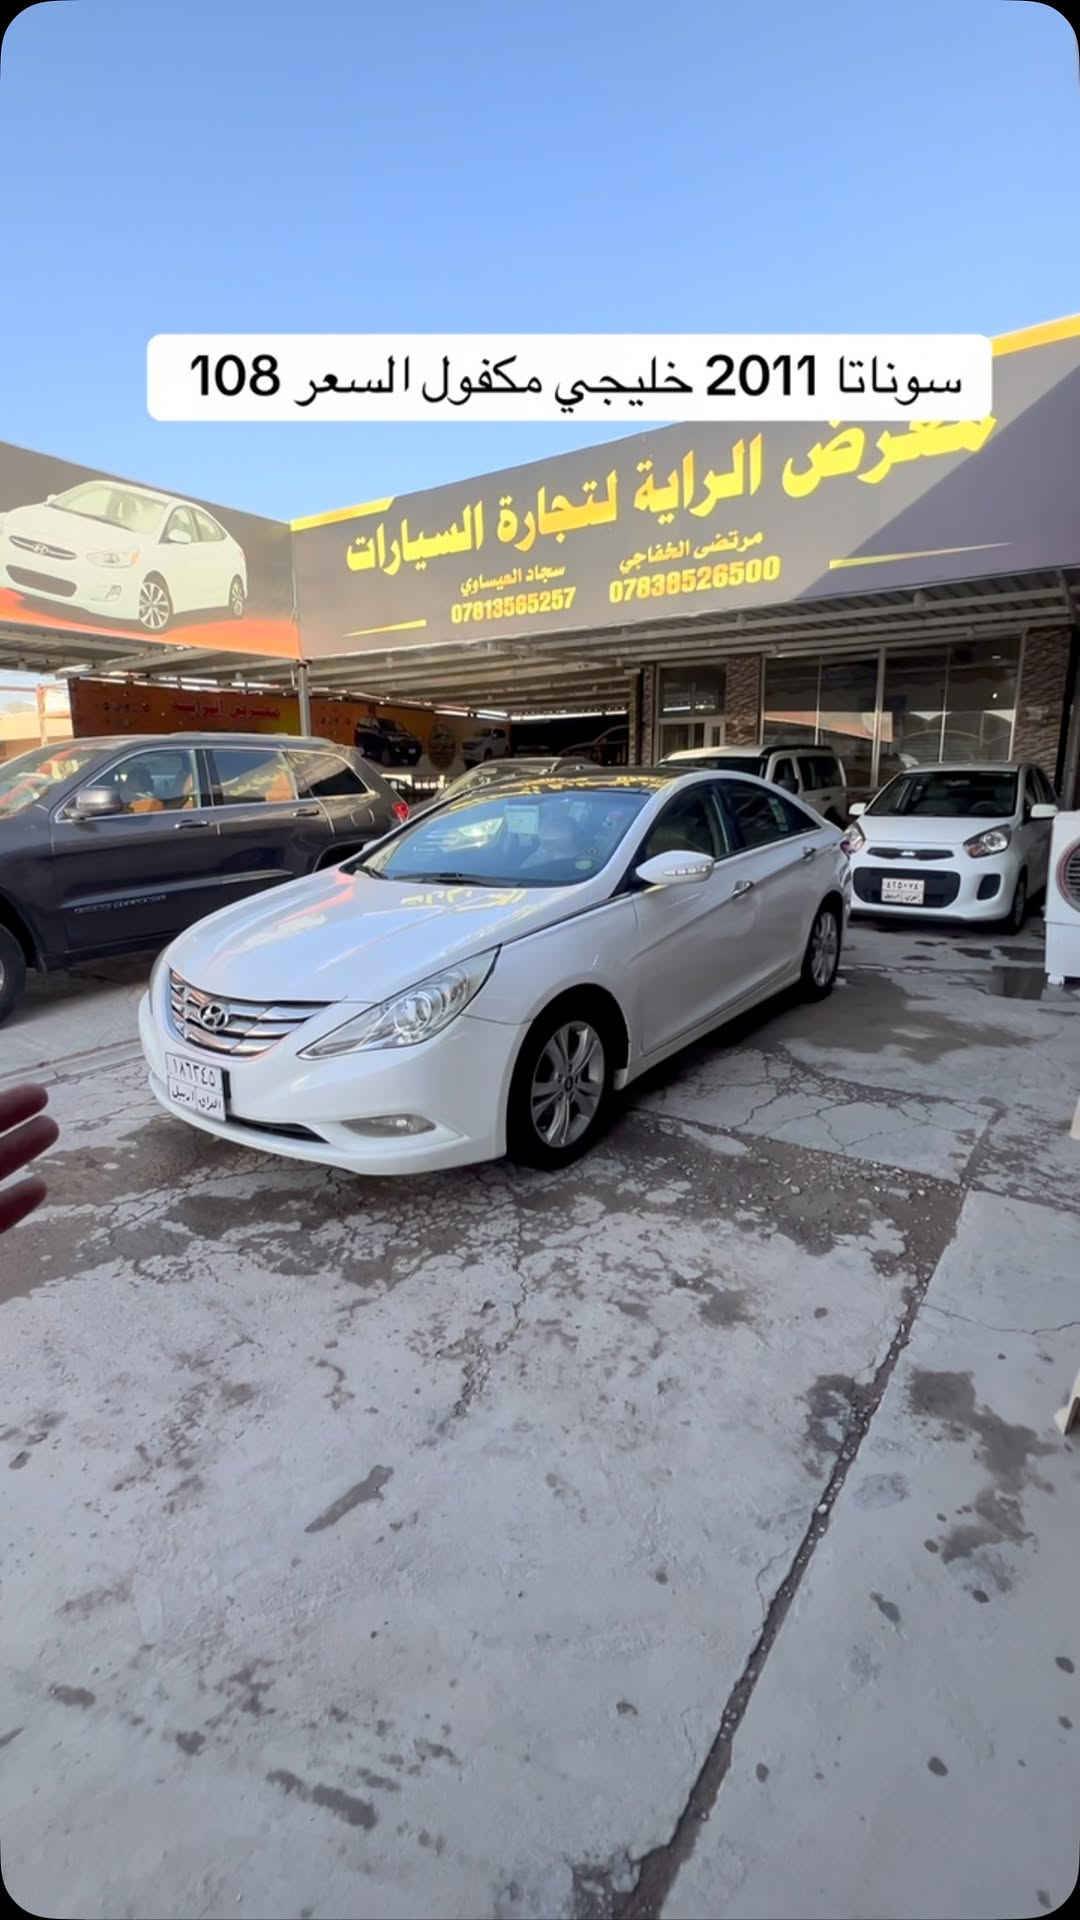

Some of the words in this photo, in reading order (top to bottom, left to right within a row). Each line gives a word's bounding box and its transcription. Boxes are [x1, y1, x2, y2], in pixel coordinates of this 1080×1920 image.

[633, 432, 763, 524] الراية
[497, 468, 618, 552] لتجارة
[346, 499, 484, 576] السيارات
[693, 529, 765, 559] مرتضى
[526, 563, 566, 584] سجاد
[619, 538, 691, 576] الخفاجي
[459, 567, 524, 598] العيساوي
